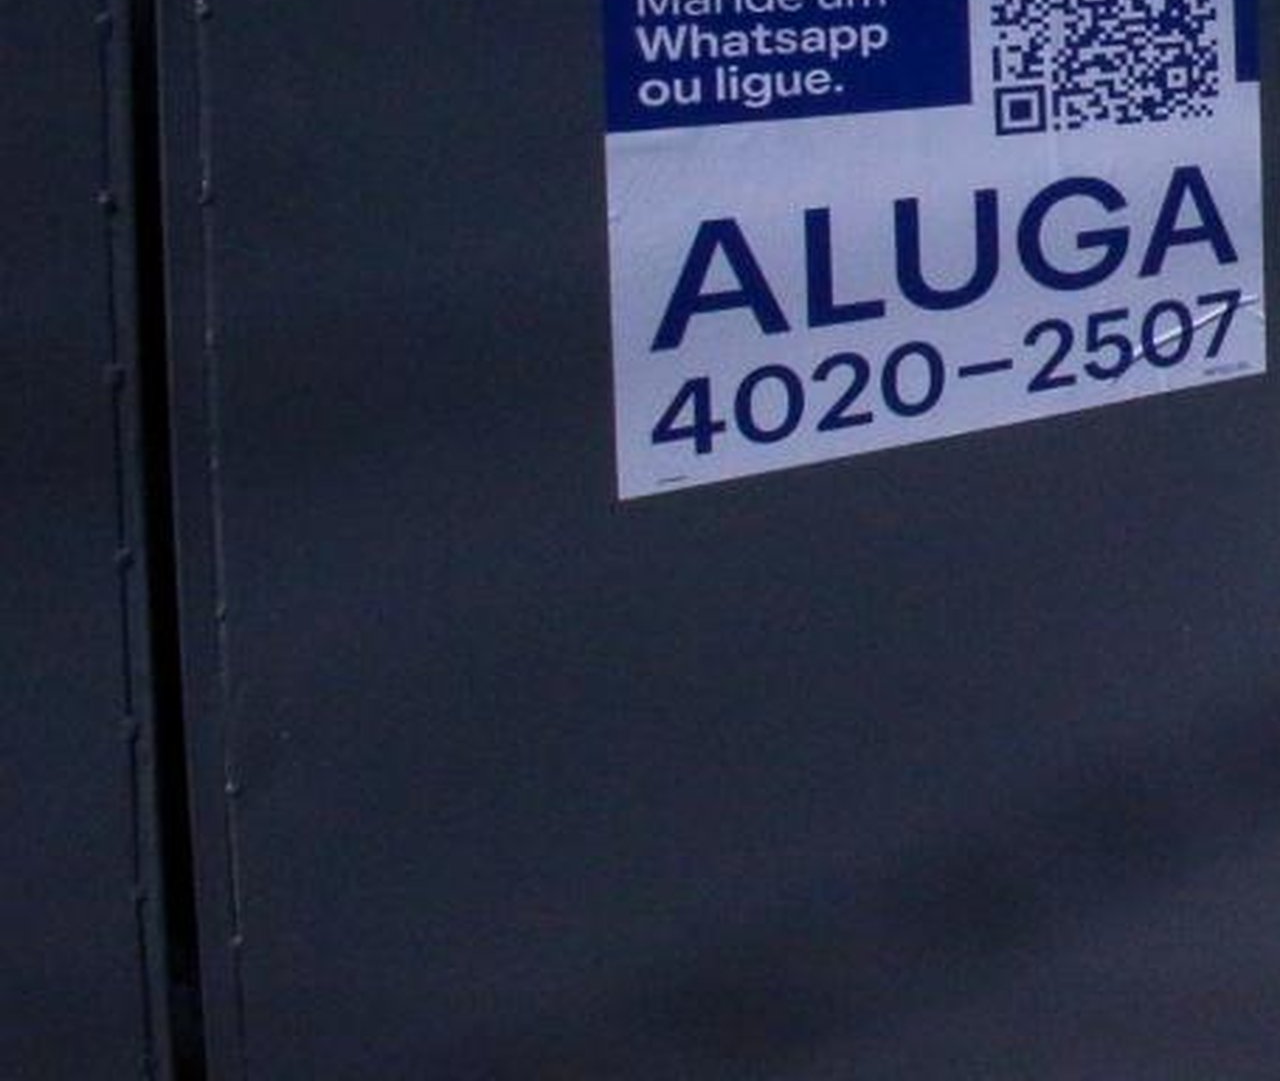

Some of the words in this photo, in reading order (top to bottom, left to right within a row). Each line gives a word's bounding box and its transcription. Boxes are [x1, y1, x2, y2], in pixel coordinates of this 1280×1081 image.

[636, 20, 889, 62] Whatsapp
[637, 76, 702, 107] ou
[715, 65, 845, 109] ligue.
[649, 165, 1240, 353] ALUGA
[650, 289, 1244, 455] 4020-2507
